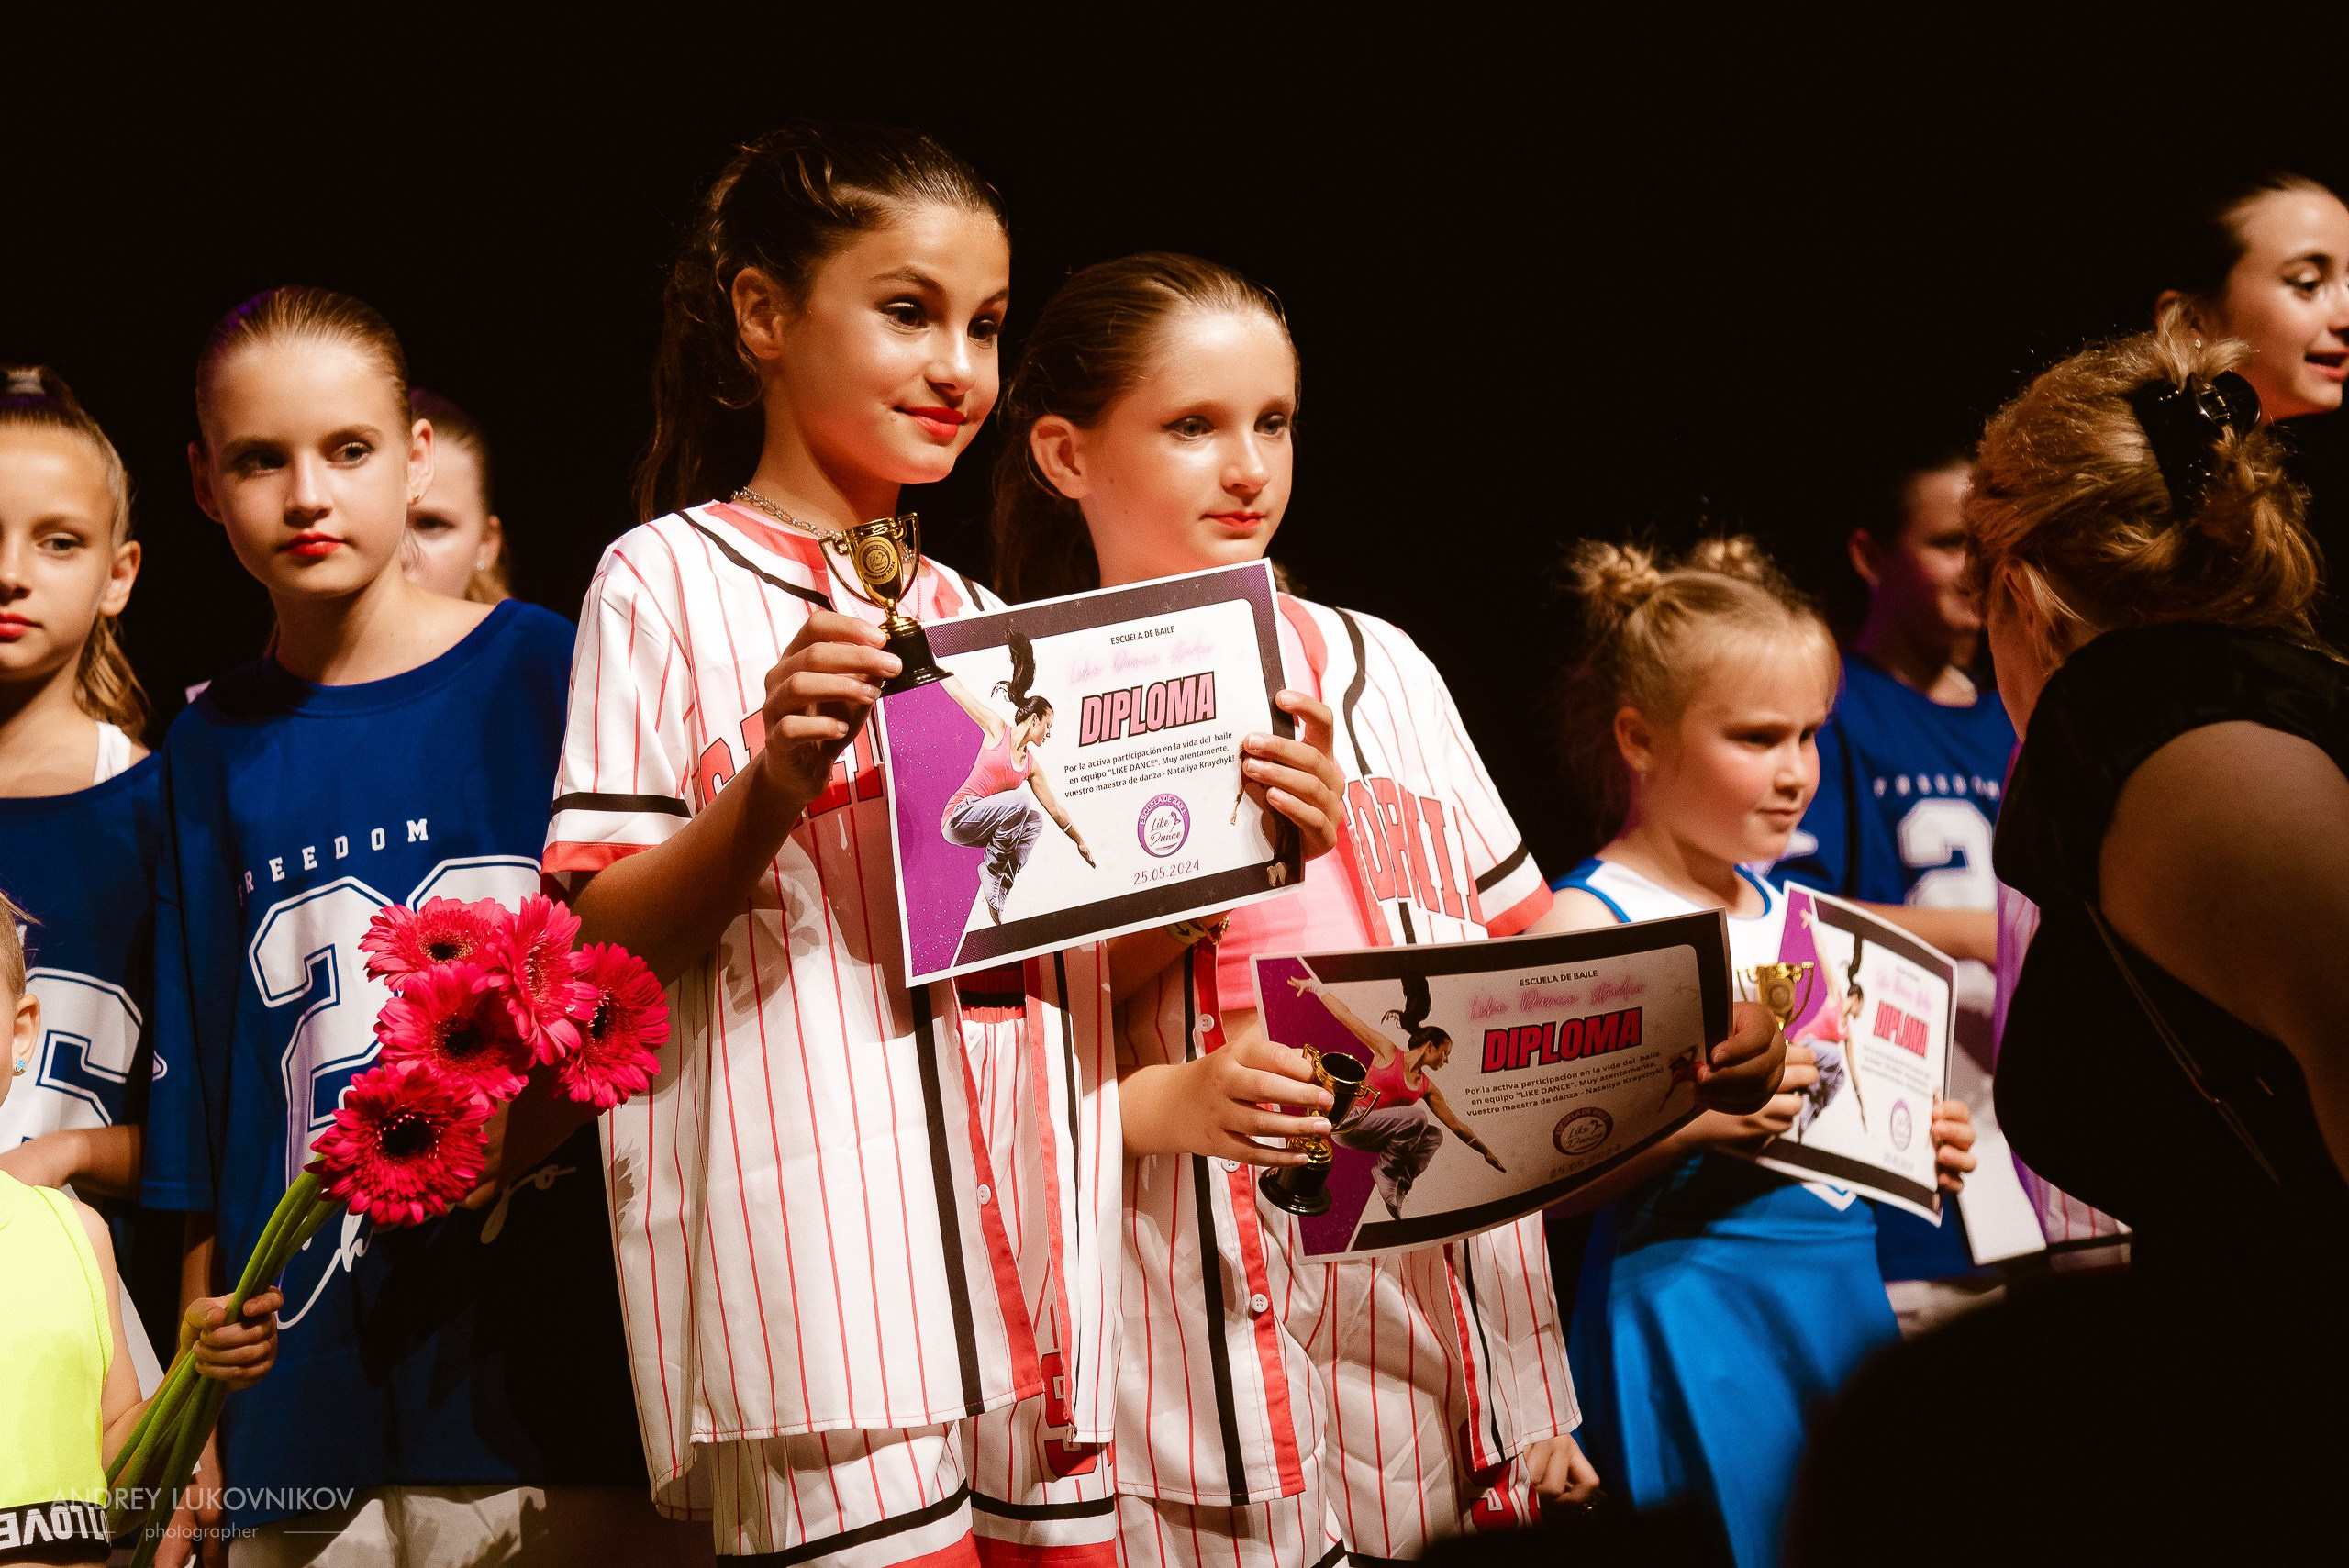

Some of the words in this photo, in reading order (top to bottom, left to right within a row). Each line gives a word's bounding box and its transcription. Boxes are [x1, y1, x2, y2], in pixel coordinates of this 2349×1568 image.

[1110, 632, 1143, 645] ESCUELA
[1144, 630, 1153, 639] DE
[1155, 626, 1175, 637] BAILE
[1078, 670, 1217, 747] DIPLOMA
[1063, 764, 1077, 773] Por
[1079, 762, 1086, 771] la
[1087, 758, 1111, 769] activa
[1112, 746, 1162, 765] participación
[1182, 740, 1198, 748] vida
[1199, 736, 1211, 745] del
[1214, 731, 1232, 741] baile
[1081, 771, 1107, 783] equipo
[1108, 765, 1128, 775] "LIKE
[1162, 756, 1178, 765] Muy
[1179, 745, 1230, 761] atentamente,
[1064, 786, 1094, 797] vuestro
[1096, 779, 1127, 792] maestra
[1128, 776, 1138, 784] de
[1139, 772, 1162, 782] danza
[1167, 763, 1197, 776] Nataliya
[1199, 754, 1235, 769] Kraychyk!
[1140, 796, 1163, 826] ESCUELA
[1163, 795, 1172, 803] DE
[1172, 796, 1187, 816] BAILE
[1150, 816, 1170, 832] Like
[1149, 831, 1182, 846] Dance
[1133, 859, 1199, 885] 25.05.2024
[1520, 974, 1559, 986] ESCUELA
[1560, 973, 1572, 982] DE
[1574, 970, 1598, 980] BAILE
[1481, 1006, 1643, 1073] DIPLOMA
[1485, 1094, 1514, 1104] equipo
[1516, 1089, 1539, 1098] "LIKE
[1579, 1077, 1598, 1086] Muy
[1599, 1062, 1656, 1081] atentamente,
[1492, 1083, 1519, 1092] activa
[1520, 1072, 1577, 1089] participación
[1602, 1062, 1620, 1072] vida
[1640, 1051, 1660, 1062] baile
[1466, 1107, 1500, 1116] vuestro
[1502, 1101, 1538, 1111] maestra
[1553, 1092, 1578, 1102] danza
[1586, 1082, 1621, 1095] Nataliya
[1623, 1067, 1664, 1084] Kraychyk!
